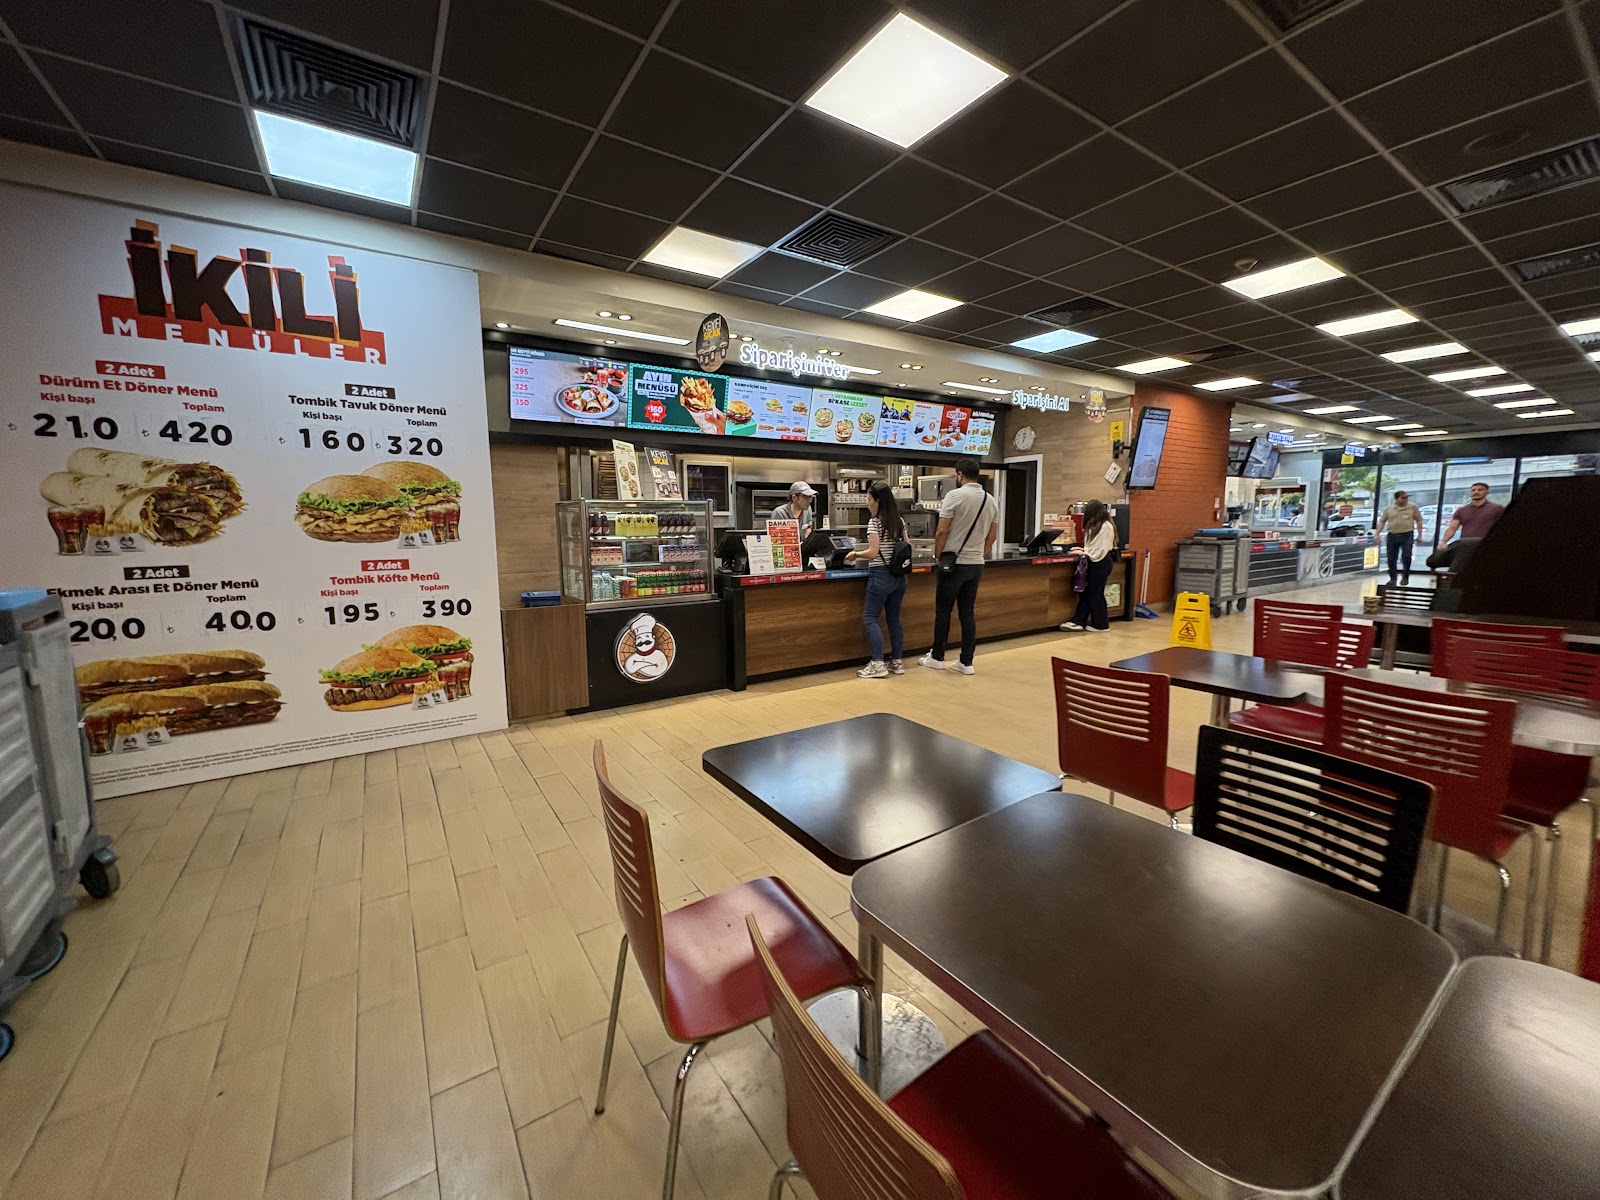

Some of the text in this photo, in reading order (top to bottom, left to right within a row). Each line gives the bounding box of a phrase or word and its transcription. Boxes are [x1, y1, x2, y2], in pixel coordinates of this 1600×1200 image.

[125, 219, 362, 344] İKİLİ
[112, 317, 381, 364] MENÜLER
[741, 343, 825, 378] Siparişini
[105, 364, 155, 378] 2 Adet
[39, 374, 219, 398] Dürüm Et Döner Menü
[351, 386, 388, 398] 2 Adet
[637, 382, 676, 393] MENÜSÜ
[40, 392, 96, 405] Kişi başı
[288, 395, 447, 416] Tombik Tavuk Döner Menü
[1013, 389, 1070, 412] Siparişini Al
[182, 402, 225, 413] Toplam
[302, 411, 343, 422] Kişi başı
[406, 418, 438, 428] Toplam
[159, 420, 233, 446] 420
[299, 428, 365, 452] 160
[387, 435, 443, 457] 320
[132, 567, 180, 579] 2 Adet
[367, 561, 402, 571] 2 Adet
[330, 572, 440, 586] Tombik Köfte Menü
[109, 585, 150, 596] Arası
[153, 583, 170, 594] Et
[173, 581, 218, 593] Döner
[221, 579, 259, 589] Menü
[320, 588, 359, 598] Kişi başı
[419, 583, 450, 592] Toplam
[206, 594, 246, 603] Toplam
[72, 601, 124, 611] Kişi başı
[422, 598, 472, 618] 390
[325, 602, 380, 625] 195
